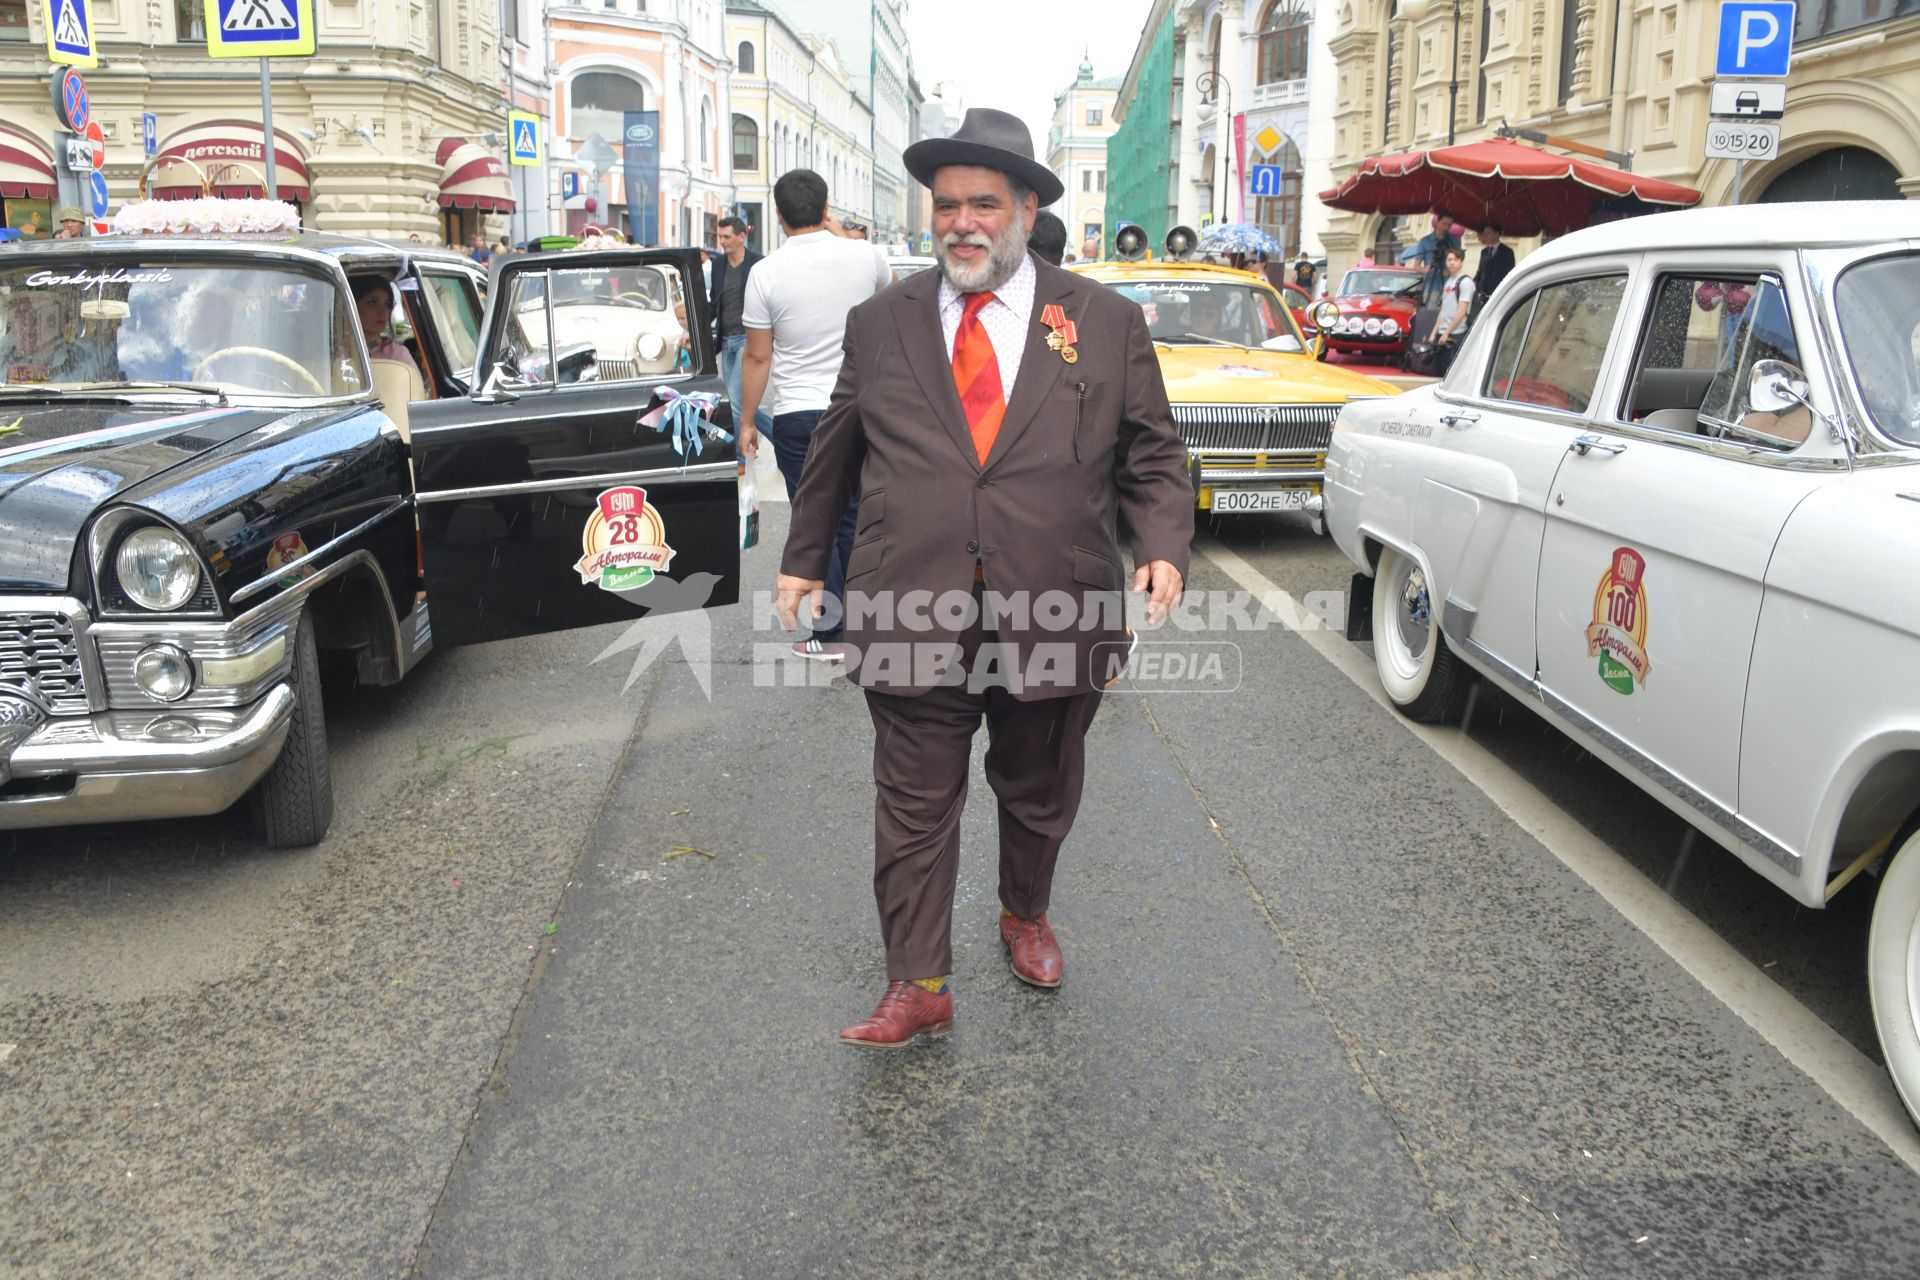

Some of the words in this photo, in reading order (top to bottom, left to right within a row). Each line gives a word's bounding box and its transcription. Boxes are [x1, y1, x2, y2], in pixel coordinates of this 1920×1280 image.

[1736, 10, 1779, 68] P
[183, 142, 262, 160] детский
[1714, 135, 1726, 146] 10
[1730, 134, 1744, 147] 15
[1748, 134, 1769, 150] 20
[610, 492, 635, 512] ГУМ
[1284, 491, 1308, 505] 750
[608, 518, 639, 546] 28
[589, 550, 661, 573] Авторалли
[608, 565, 647, 587] Весна
[1607, 589, 1637, 633] 100
[1603, 662, 1631, 679] Весна
